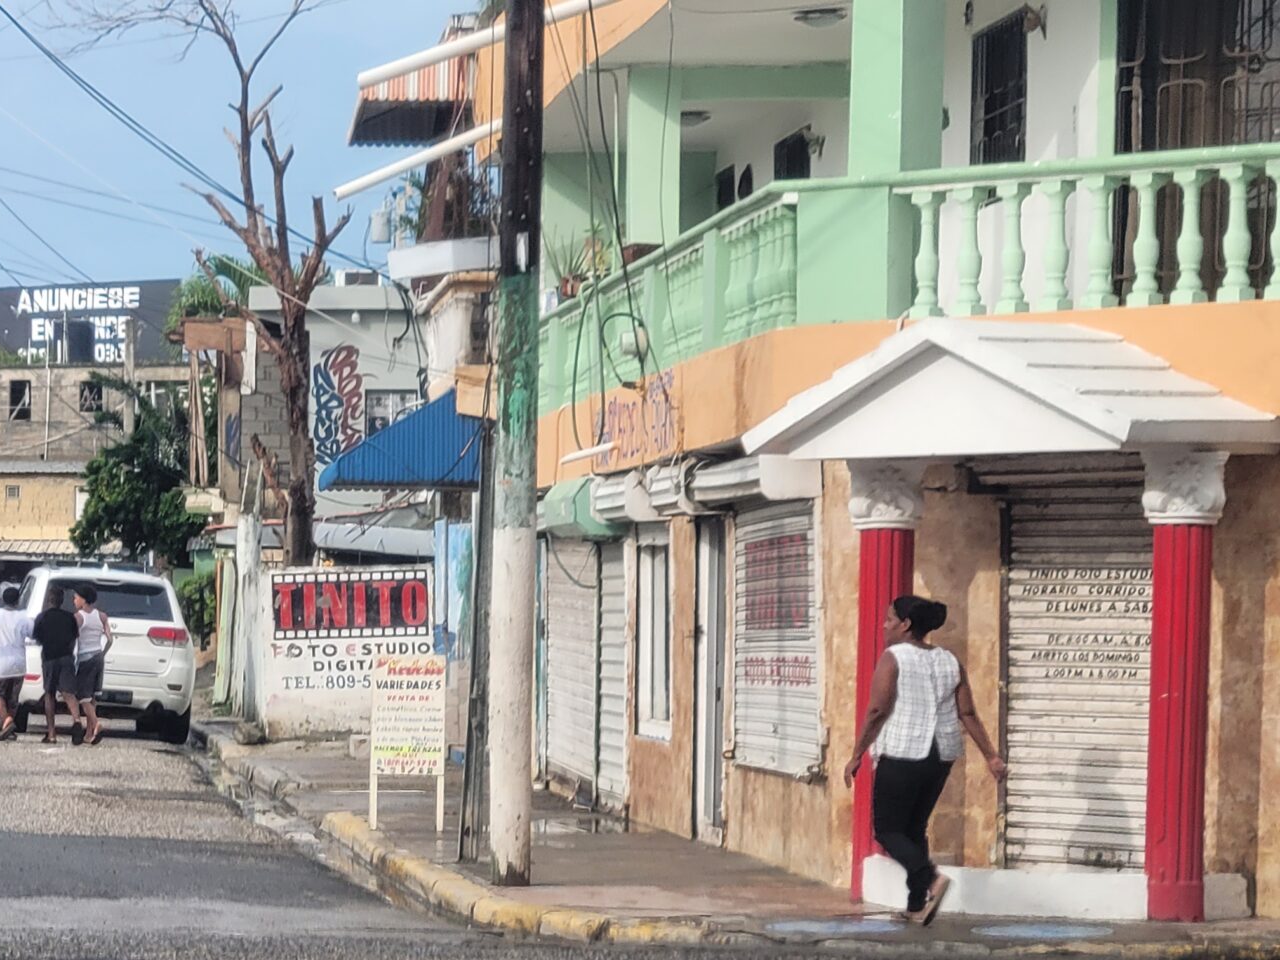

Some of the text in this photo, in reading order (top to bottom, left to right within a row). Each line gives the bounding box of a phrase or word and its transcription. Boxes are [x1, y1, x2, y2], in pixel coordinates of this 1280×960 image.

[1028, 569, 1153, 580] TINITO FOTO ESTUDI
[1022, 585, 1146, 596] HORARIO CORRIDO
[274, 580, 427, 629] TINITO
[1108, 602, 1117, 612] A
[345, 642, 431, 657] ESTUDIO
[1072, 652, 1089, 662] LOS
[1093, 653, 1140, 663] DOMINGO
[326, 675, 371, 690] 809-5
[375, 680, 441, 690] VARIEDADES
